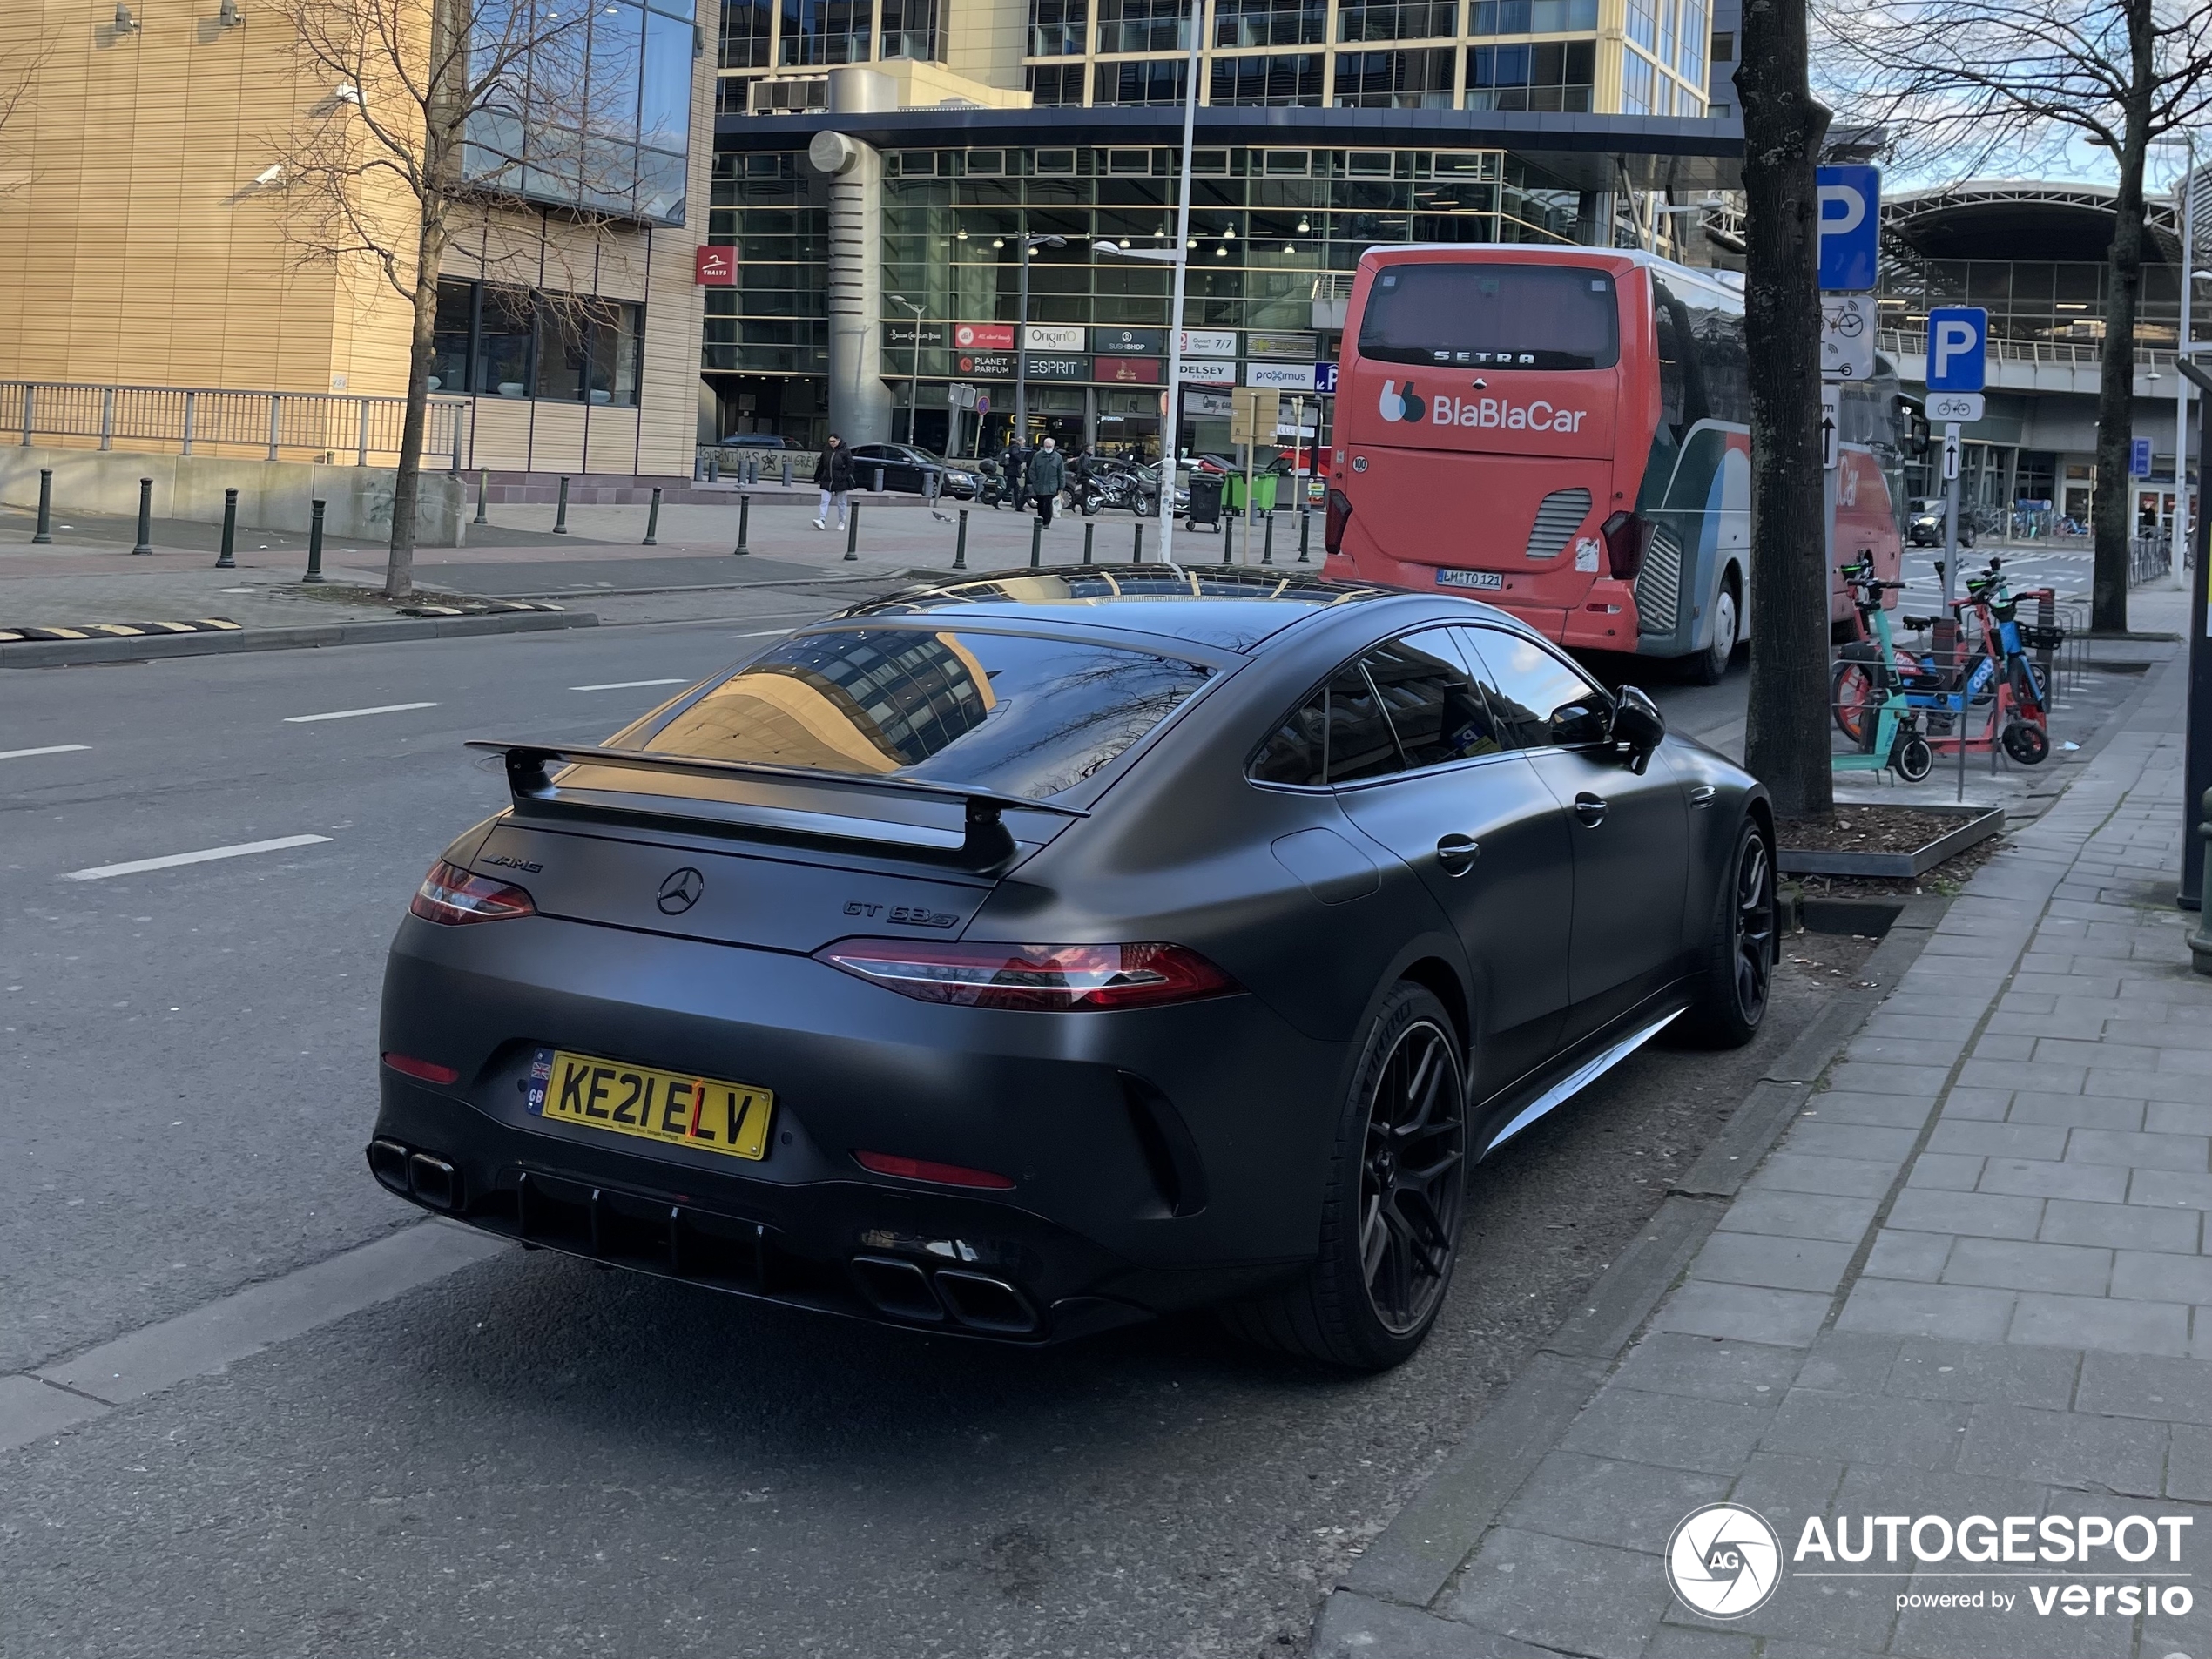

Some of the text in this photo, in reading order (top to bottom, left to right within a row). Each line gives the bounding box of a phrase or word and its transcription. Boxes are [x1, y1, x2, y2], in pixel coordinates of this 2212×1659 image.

[1817, 185, 1866, 270] P
[1031, 329, 1076, 347] Origin'O
[1215, 339, 1232, 349] 7/7
[1935, 320, 1977, 378] P
[1433, 350, 1534, 364] SETRA
[1030, 361, 1077, 374] ESPRIT
[1180, 365, 1224, 374] DELSEY
[1433, 395, 1587, 433] BlaBlaCar
[1354, 458, 1366, 469] 100
[1480, 574, 1500, 586] 121
[494, 856, 543, 873] AMG
[843, 900, 883, 917] GT
[529, 1089, 543, 1103] GB
[559, 1062, 752, 1145] KE21 ELV
